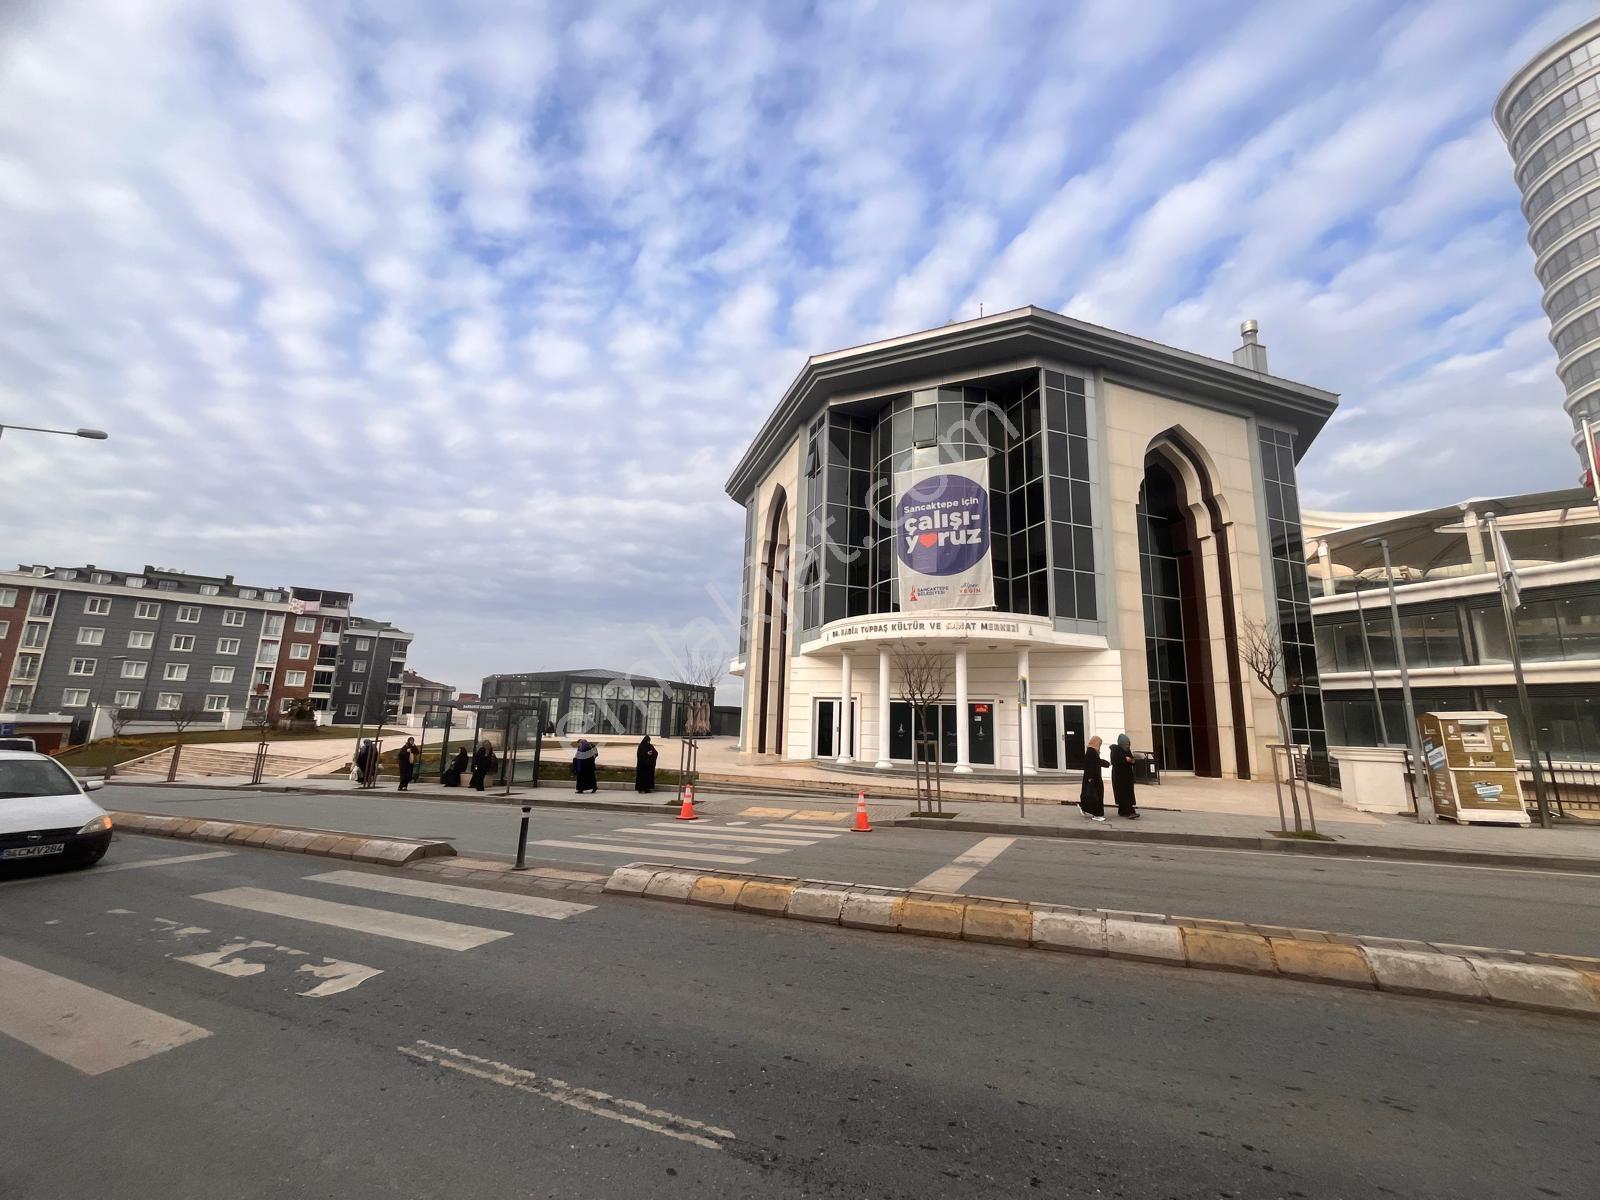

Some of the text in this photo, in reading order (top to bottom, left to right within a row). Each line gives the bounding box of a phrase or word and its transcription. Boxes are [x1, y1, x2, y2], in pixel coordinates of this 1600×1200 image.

[904, 496, 979, 514] Sancaktepe için
[904, 510, 980, 535] çalışı-
[891, 621, 925, 631] KÜLTÜR
[929, 622, 941, 630] VE
